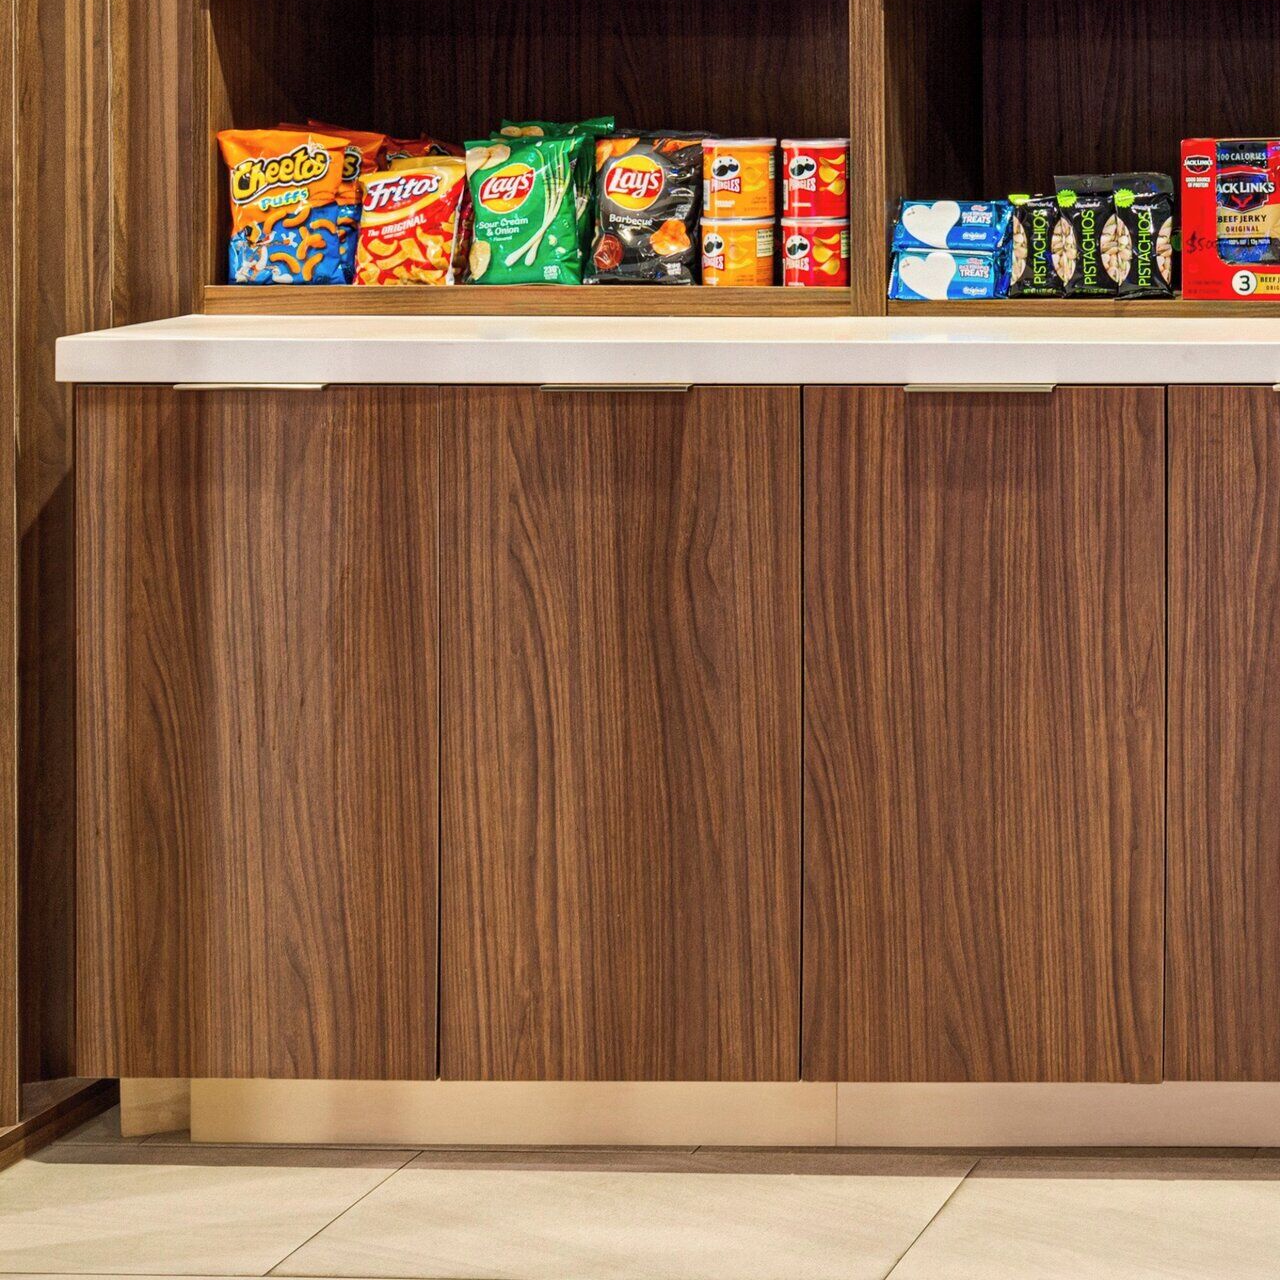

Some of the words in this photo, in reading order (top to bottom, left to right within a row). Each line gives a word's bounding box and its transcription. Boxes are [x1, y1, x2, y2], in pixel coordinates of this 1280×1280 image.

[1231, 152, 1266, 161] CALORIES
[233, 150, 328, 197] Cheetos
[609, 168, 661, 198] Lay's
[260, 189, 309, 209] Puffs
[363, 174, 440, 211] Fritos
[381, 217, 426, 235] ORIGINAL
[501, 218, 528, 226] Cream
[609, 214, 652, 226] Barbecue
[962, 216, 991, 225] TREATS
[1217, 215, 1237, 223] BEEF
[1239, 214, 1266, 223] JERKY
[487, 227, 494, 235] &
[495, 226, 520, 234] Onion
[1034, 209, 1046, 284] PISTACHIOS
[1082, 210, 1094, 285] PISTACHIOS
[1138, 210, 1151, 286] PISTACHIOS
[960, 270, 989, 279] TREATS
[1239, 276, 1251, 292] 3
